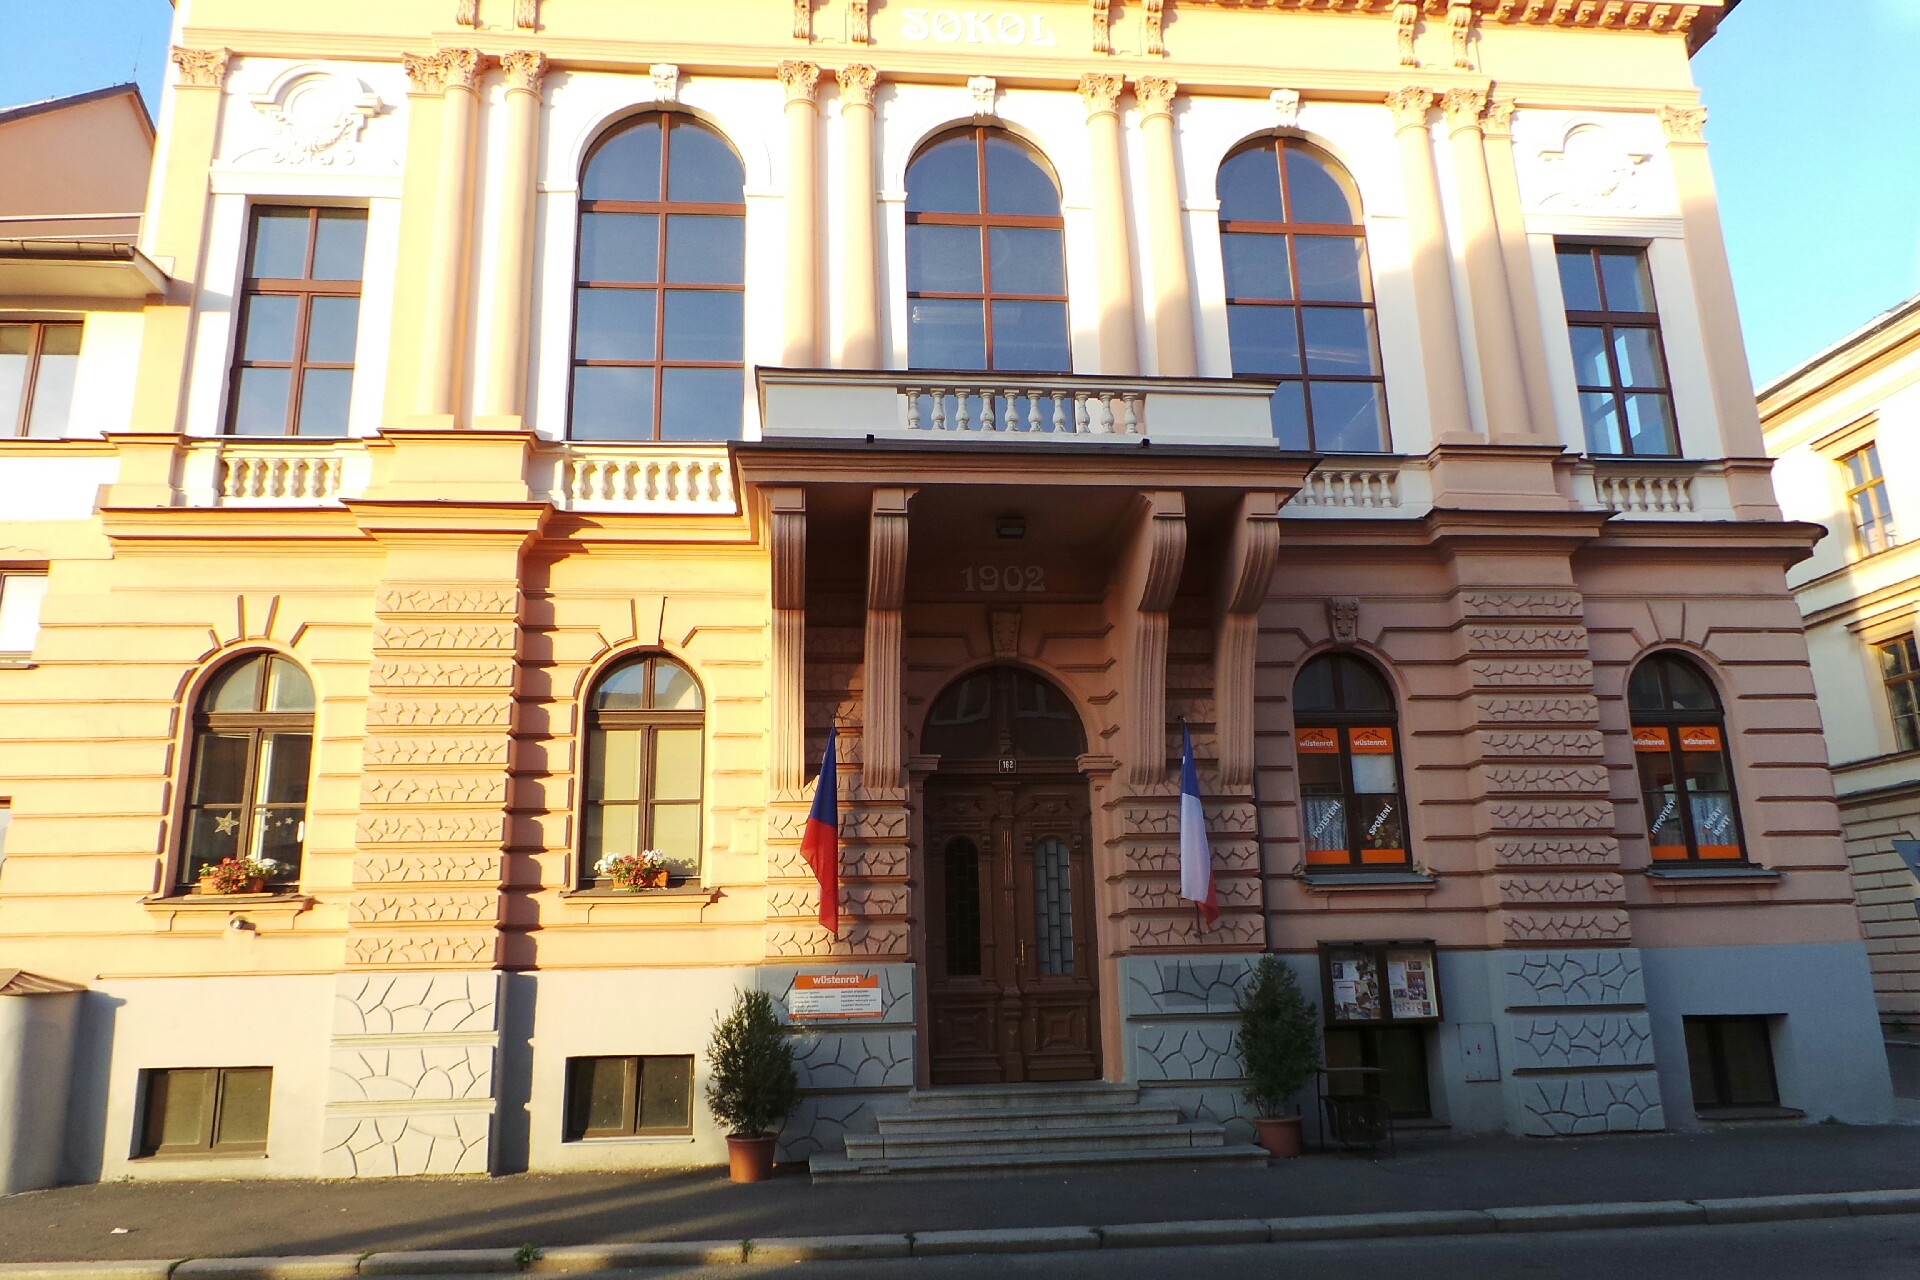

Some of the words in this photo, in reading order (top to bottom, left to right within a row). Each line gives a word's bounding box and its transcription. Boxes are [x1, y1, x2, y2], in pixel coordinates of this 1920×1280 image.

[901, 9, 1057, 46] SOKOL
[960, 565, 1046, 592] 1902
[1299, 739, 1333, 747] wüstenrot
[1002, 760, 1014, 769] 162
[1312, 799, 1342, 838] POJIŠTĚNÍ
[1368, 802, 1393, 836] SPOŘENÍ
[1650, 799, 1676, 835] HYPOTÉKY
[812, 975, 859, 984] wüstenrot
